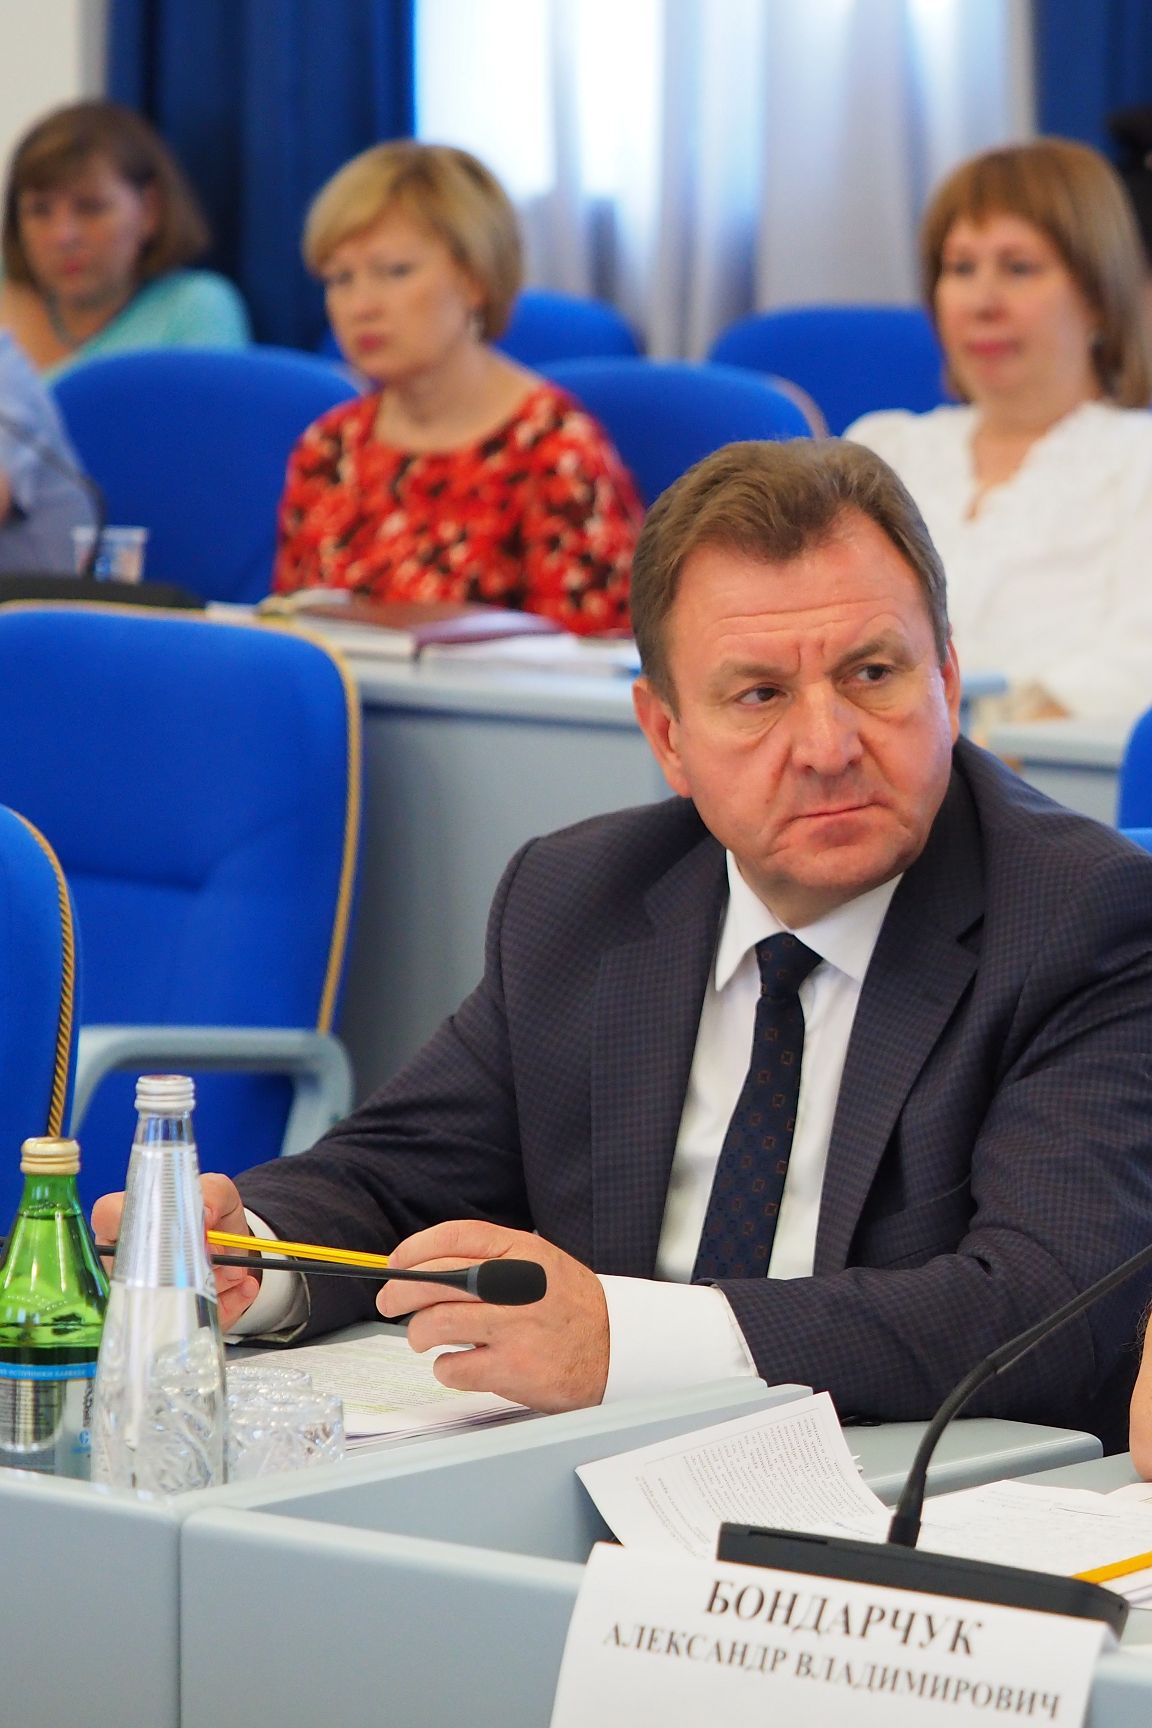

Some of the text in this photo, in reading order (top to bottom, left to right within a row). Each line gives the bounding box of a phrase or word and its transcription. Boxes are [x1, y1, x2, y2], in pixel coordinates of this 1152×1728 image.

[705, 1578, 984, 1656] БОНДАРЧУК
[602, 1621, 1061, 1720] АЛЕКСАНДР ВЛАДИМИРОВИЧ
